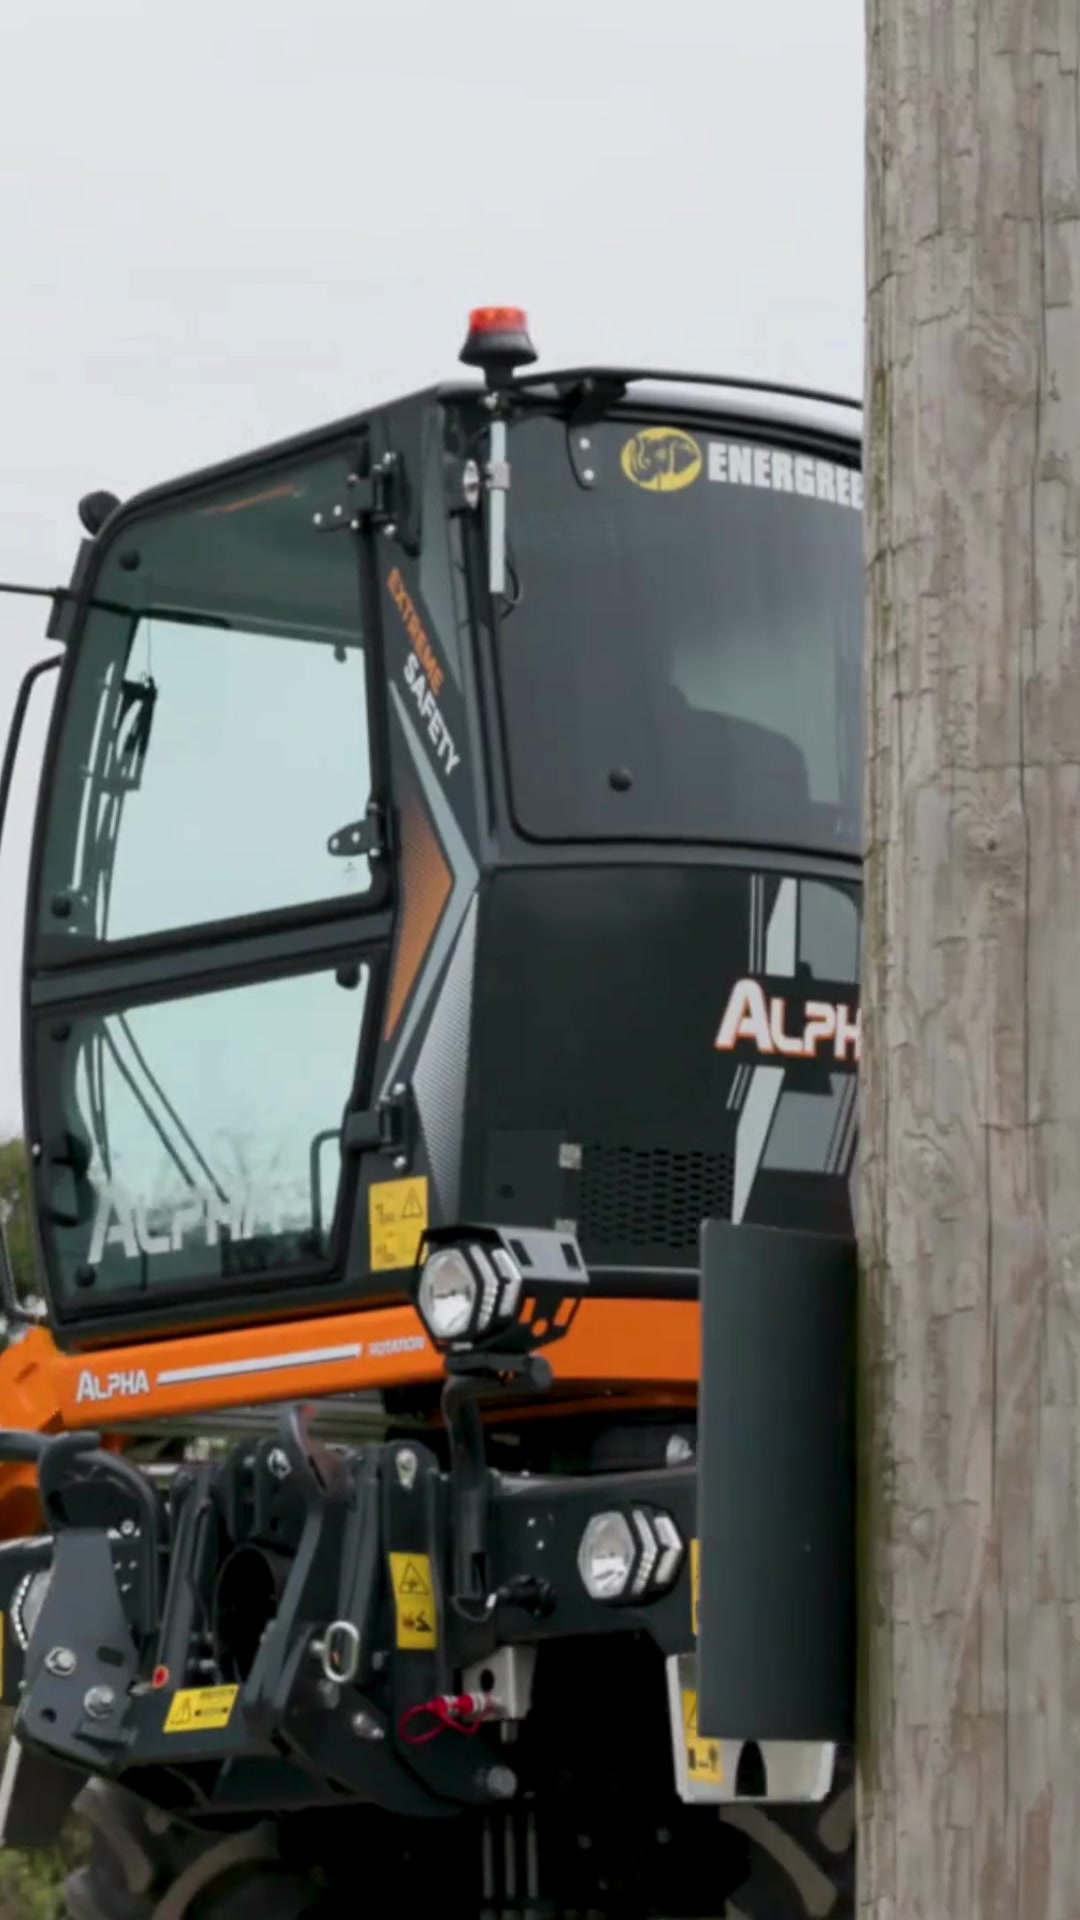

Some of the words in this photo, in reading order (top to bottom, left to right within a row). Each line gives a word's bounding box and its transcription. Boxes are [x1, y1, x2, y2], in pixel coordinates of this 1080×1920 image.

[386, 566, 445, 697] EXTREME
[403, 652, 461, 776] SAFETY
[714, 977, 863, 1061] ALPH
[76, 1368, 150, 1403] ALPHA
